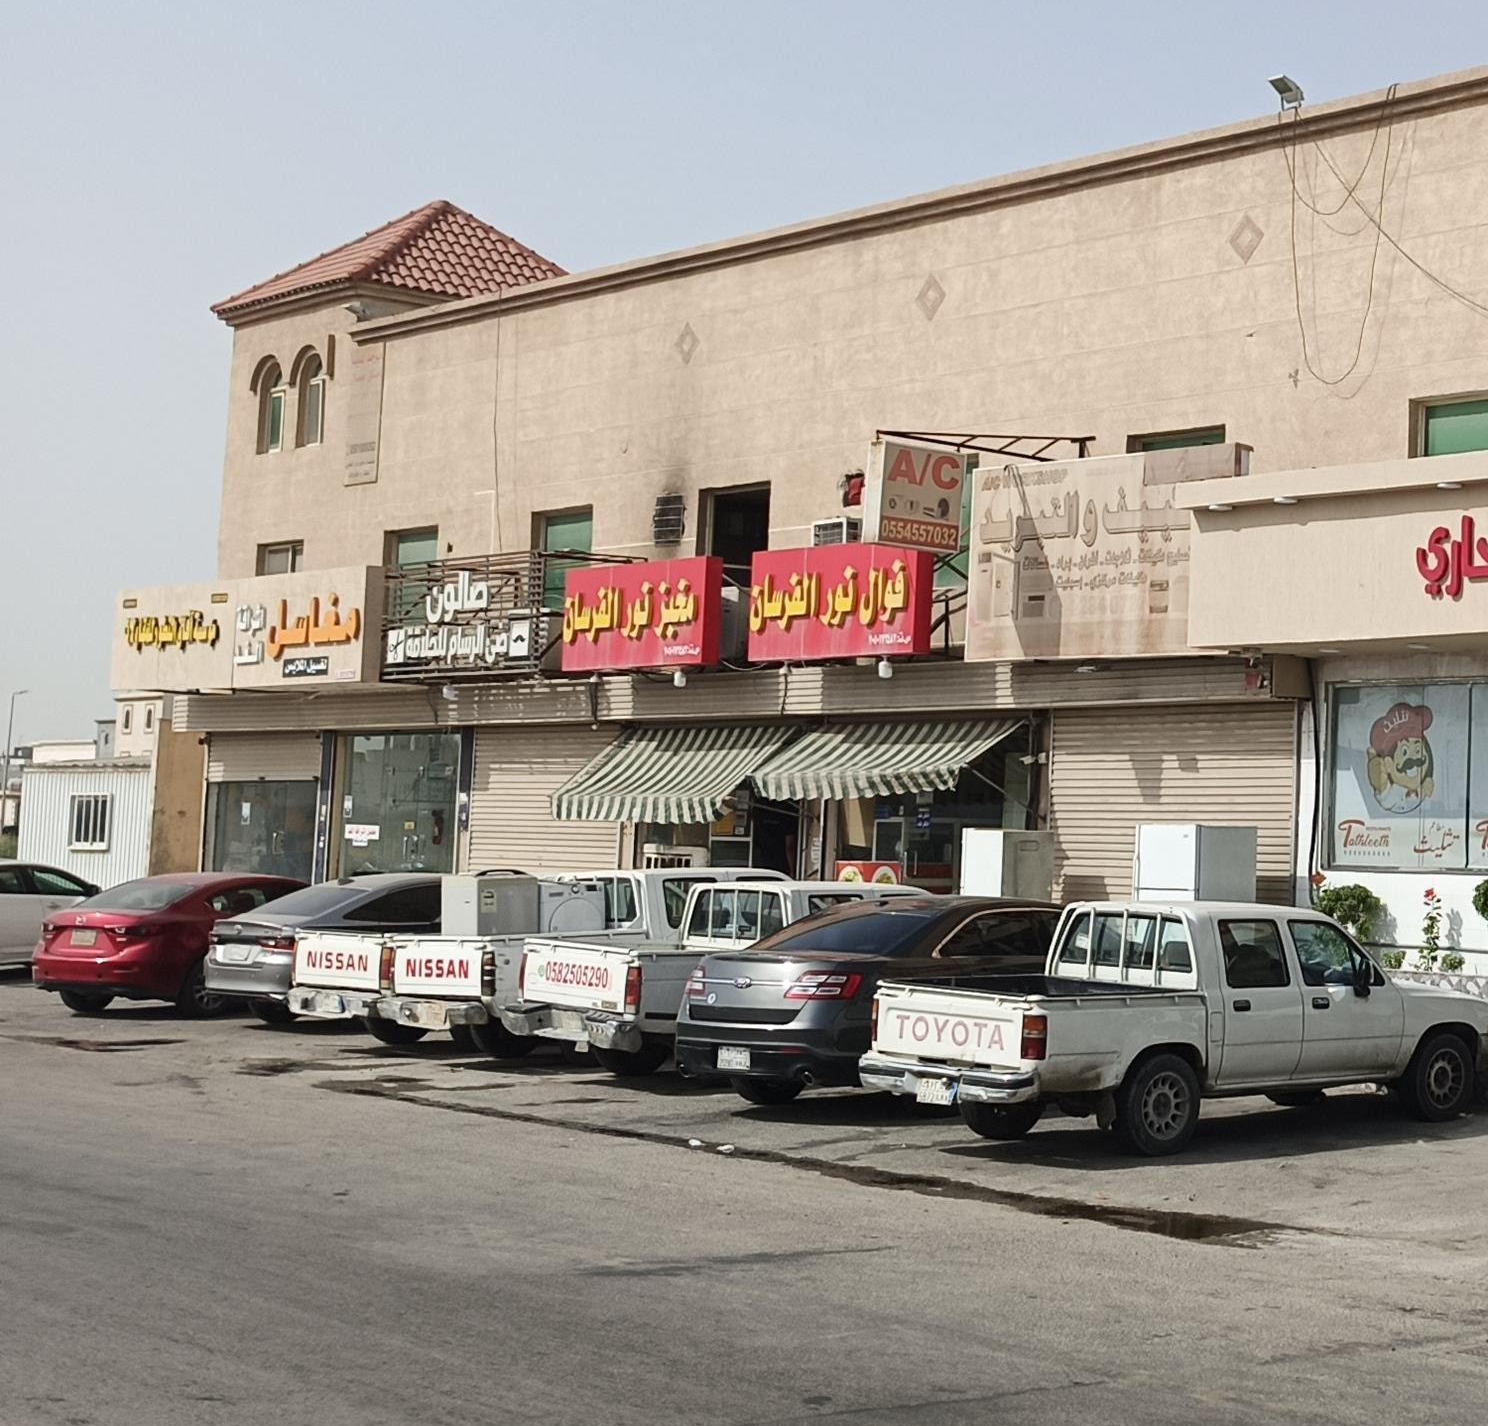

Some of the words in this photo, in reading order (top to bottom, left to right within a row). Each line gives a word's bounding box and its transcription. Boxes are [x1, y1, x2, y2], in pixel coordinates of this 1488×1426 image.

[887, 448, 960, 490] A/C
[881, 520, 957, 545] 0554557032
[426, 571, 489, 623] صالون
[562, 586, 623, 645] الفرسان
[620, 581, 653, 640] نور
[749, 572, 821, 633] الفرسان
[819, 565, 857, 628] نور
[858, 559, 907, 627] فوال
[267, 593, 361, 661] مغاسل
[306, 951, 368, 972] NISSAN
[406, 959, 469, 979] NISSAN
[545, 961, 609, 989] 0582505290
[896, 1014, 1004, 1051] TOYOTA
